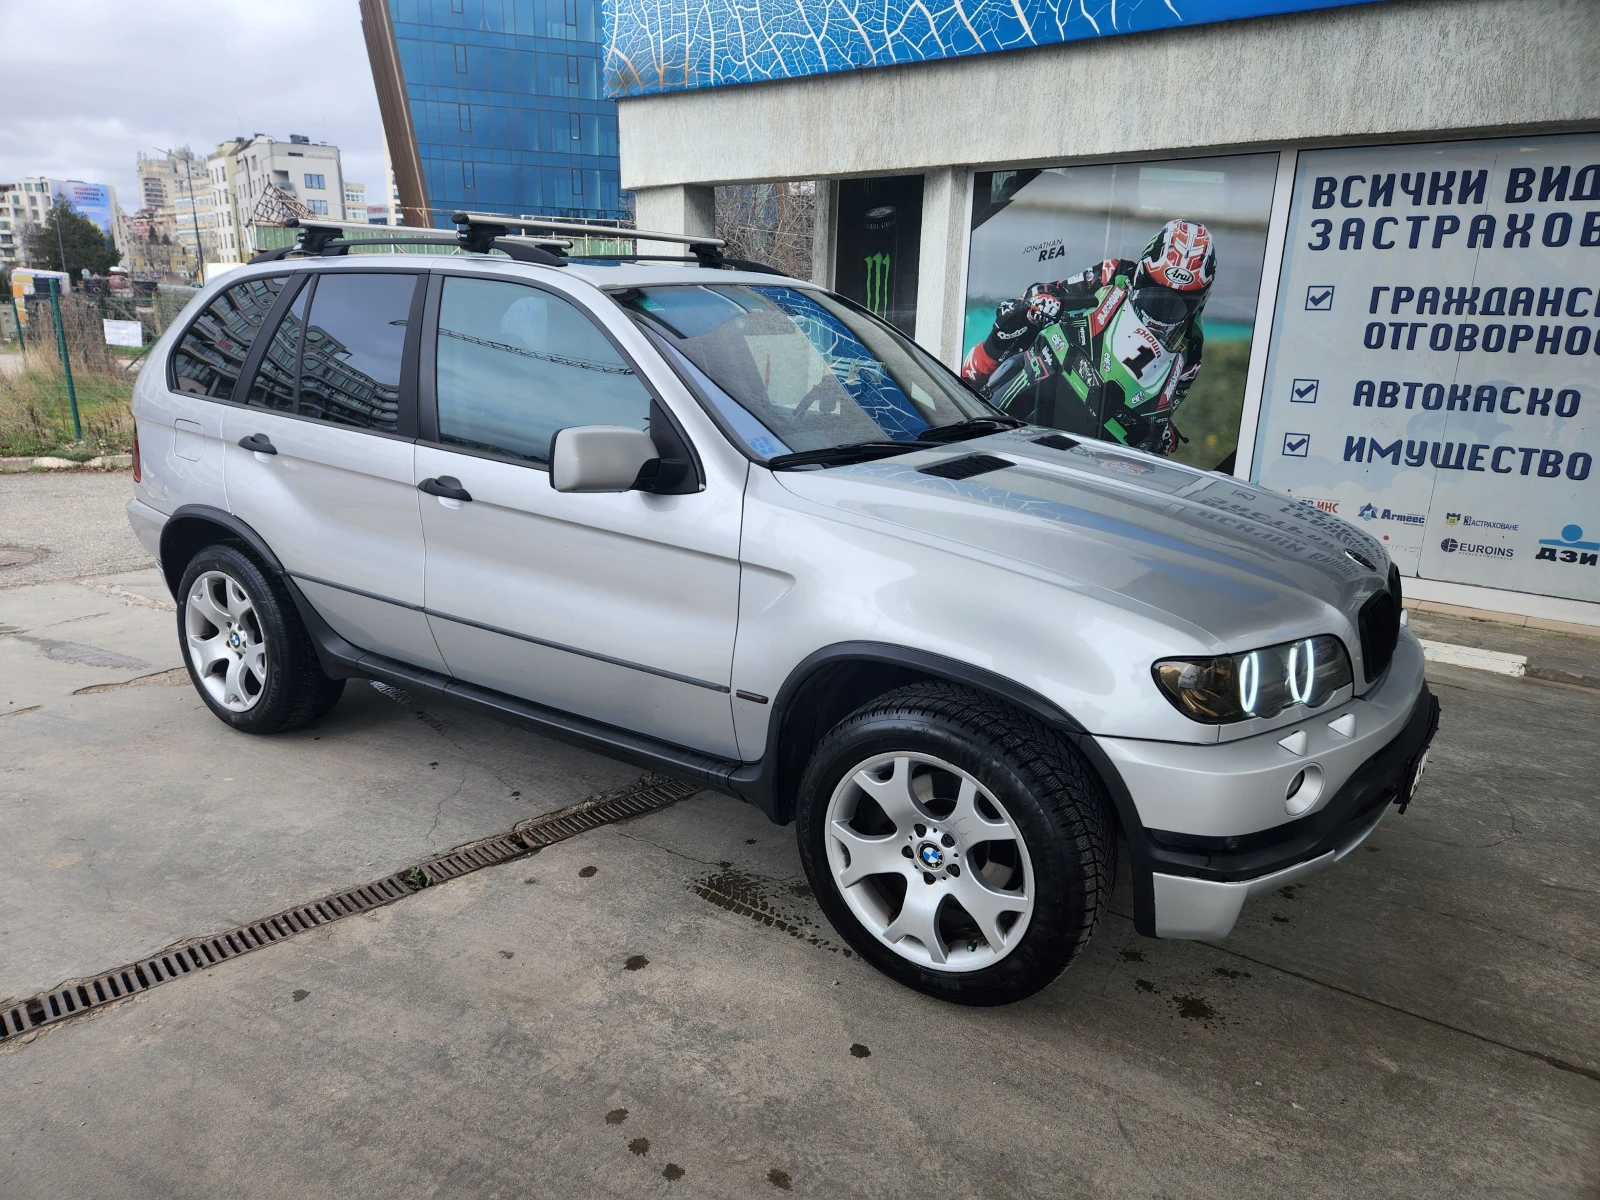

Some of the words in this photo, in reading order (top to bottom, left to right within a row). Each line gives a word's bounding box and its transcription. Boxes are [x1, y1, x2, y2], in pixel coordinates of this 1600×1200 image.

[1312, 170, 1488, 209] ВСИЧКИ
[1504, 164, 1600, 203] ВИД
[1307, 211, 1600, 250] ЗАСТРАХОВ
[1022, 238, 1063, 254] JONATHAN
[1038, 245, 1066, 262] REA
[1166, 269, 1190, 281] Arai
[1368, 286, 1600, 317] ГРАЖДАНС
[1133, 328, 1162, 358] SHOWA
[1121, 345, 1156, 380] 1
[1352, 379, 1582, 418] АВТОКАСКО
[1343, 435, 1593, 481] ИМУЩЕСТВО
[1316, 500, 1340, 514] ИНС
[1380, 508, 1425, 524] Armeec
[1463, 515, 1519, 531] ЗАСТРАХОВАНЕ
[1459, 542, 1514, 557] EUROINS
[1535, 547, 1599, 566] ДЗИ
